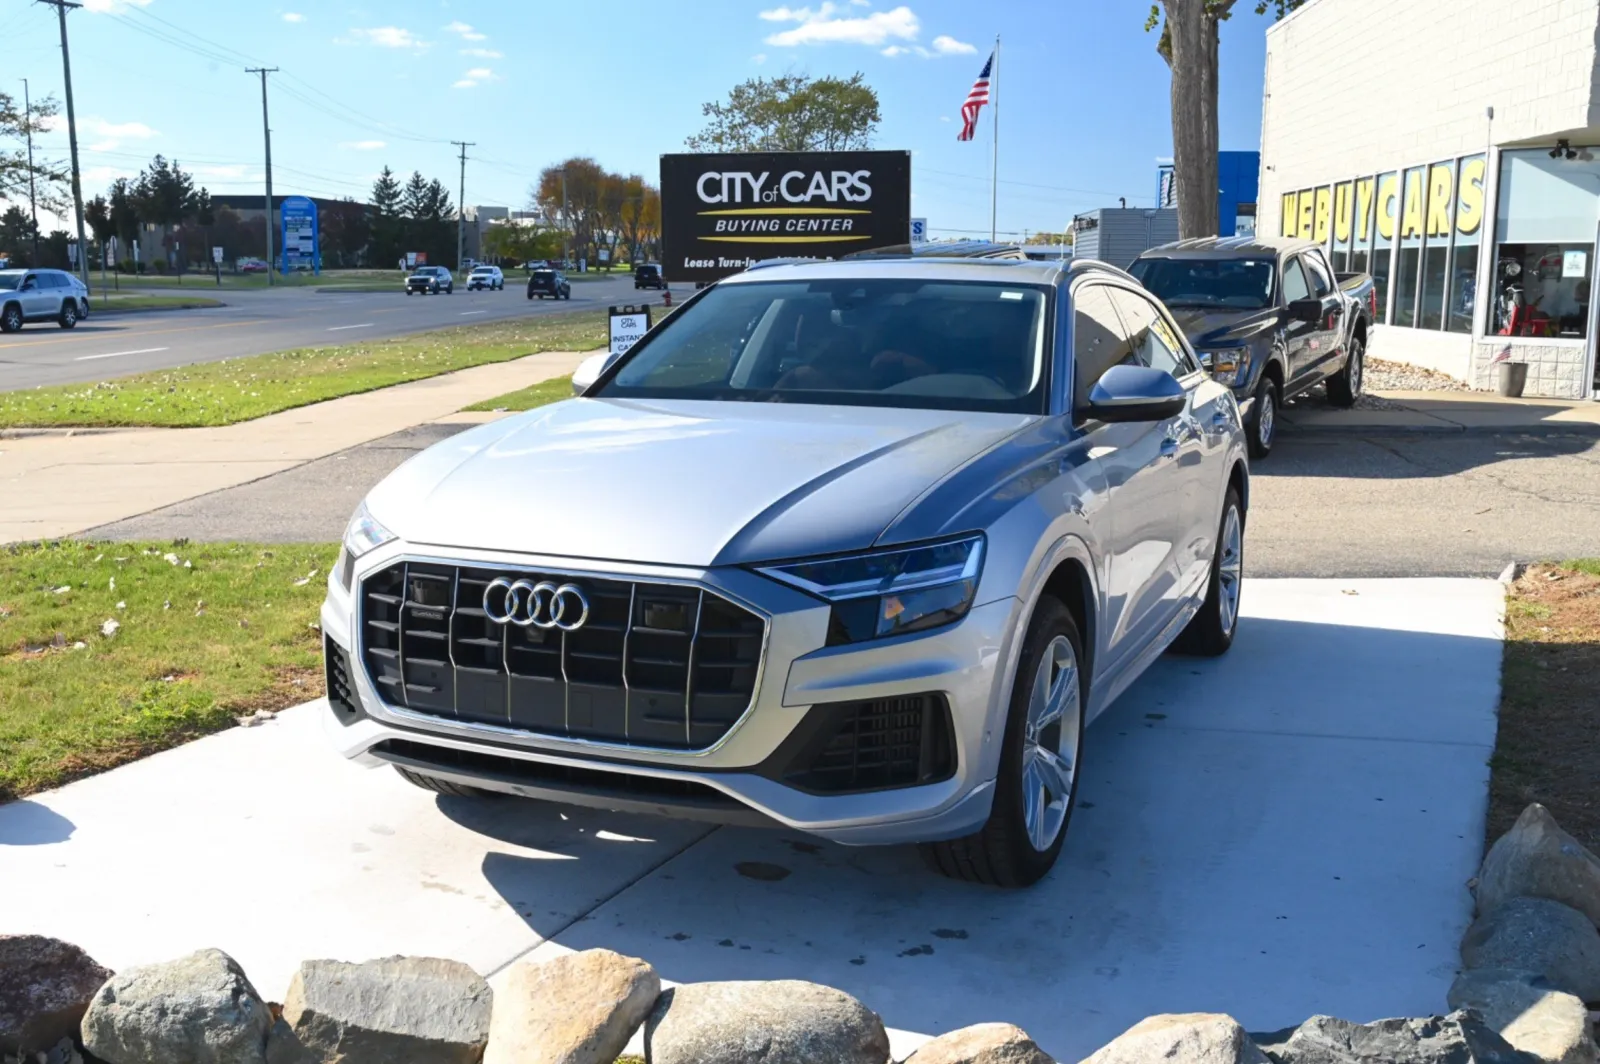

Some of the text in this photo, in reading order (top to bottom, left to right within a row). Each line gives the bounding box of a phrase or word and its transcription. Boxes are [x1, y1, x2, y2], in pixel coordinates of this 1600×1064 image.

[696, 170, 872, 204] CITY of CARS
[715, 218, 853, 232] BUYING CENTER
[684, 257, 715, 268] Lease
